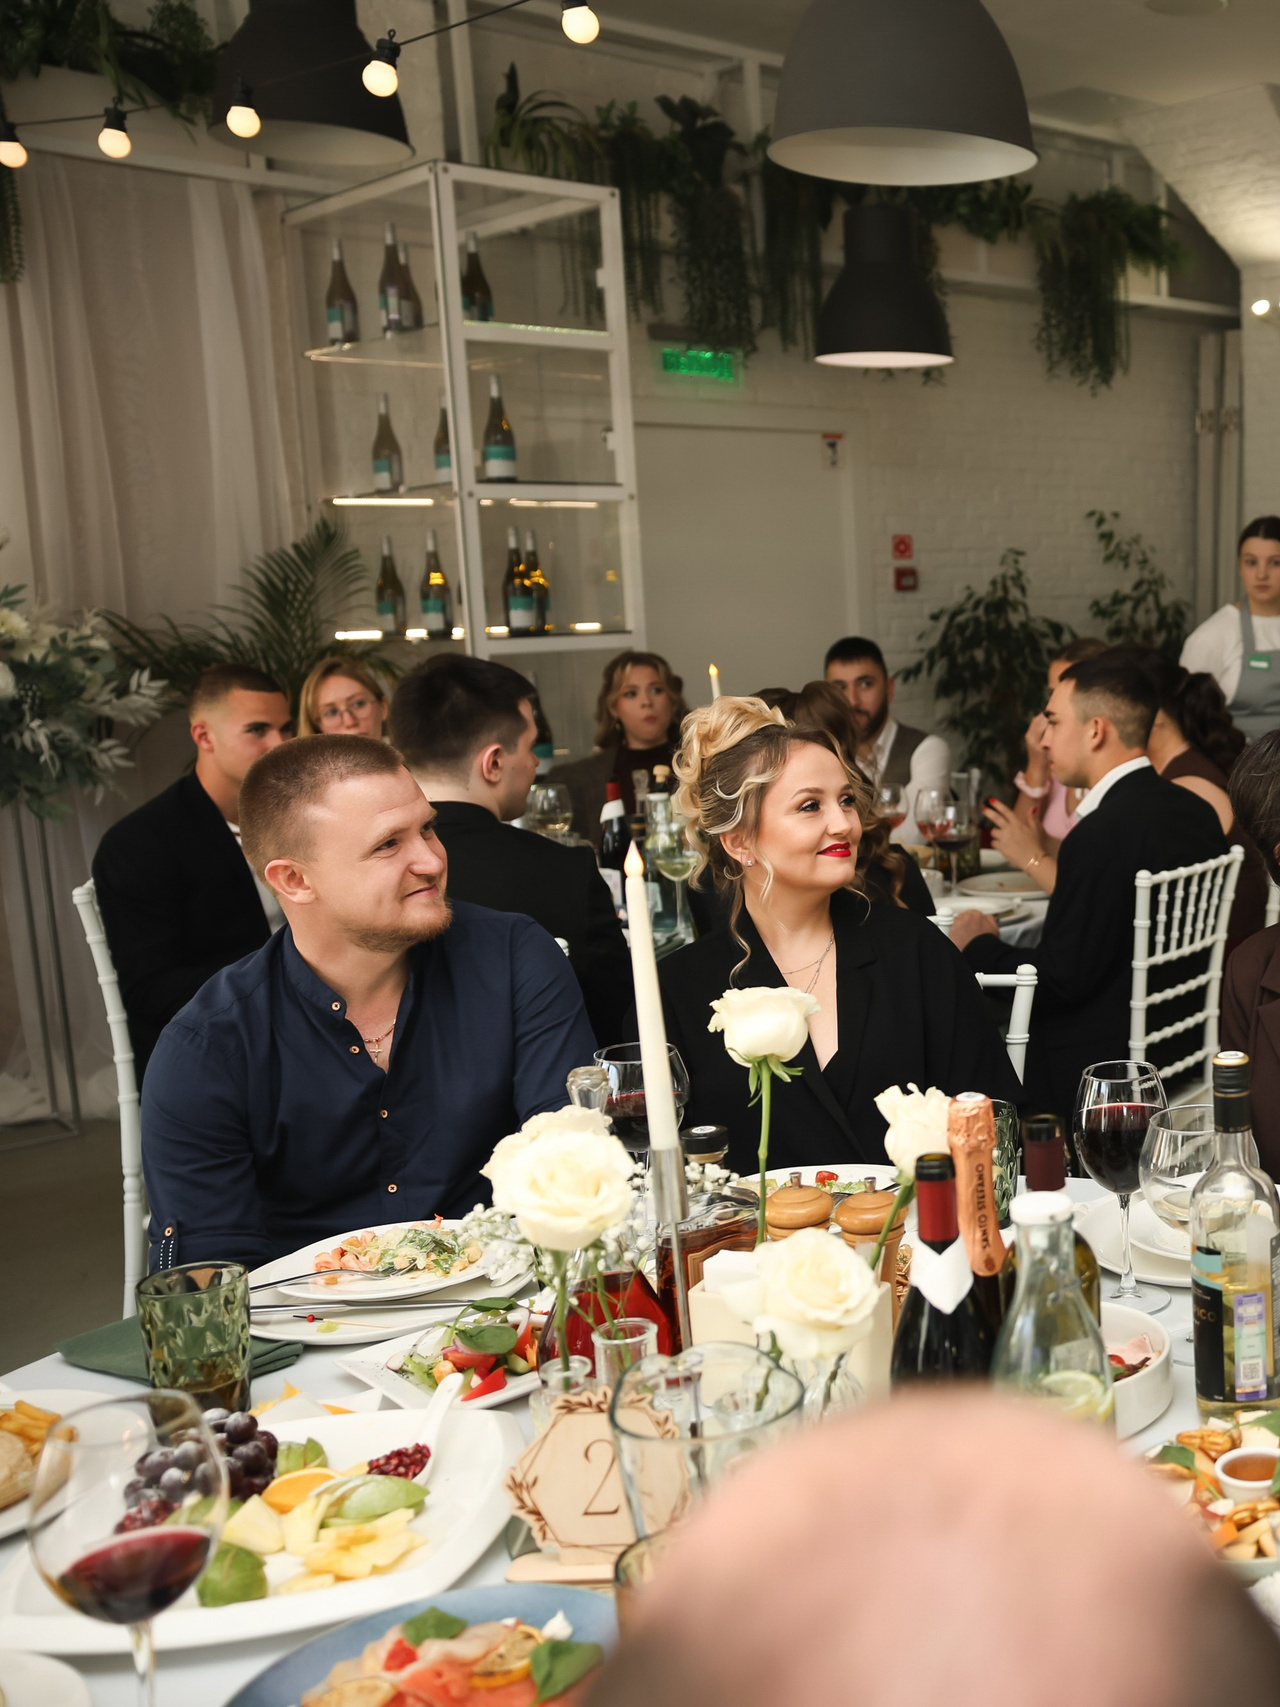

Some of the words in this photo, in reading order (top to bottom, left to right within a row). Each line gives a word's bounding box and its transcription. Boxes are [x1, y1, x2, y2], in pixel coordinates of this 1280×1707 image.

[975, 1163, 986, 1211] STEFANO
[978, 1214, 990, 1250] SANTO
[582, 1438, 620, 1516] 2
